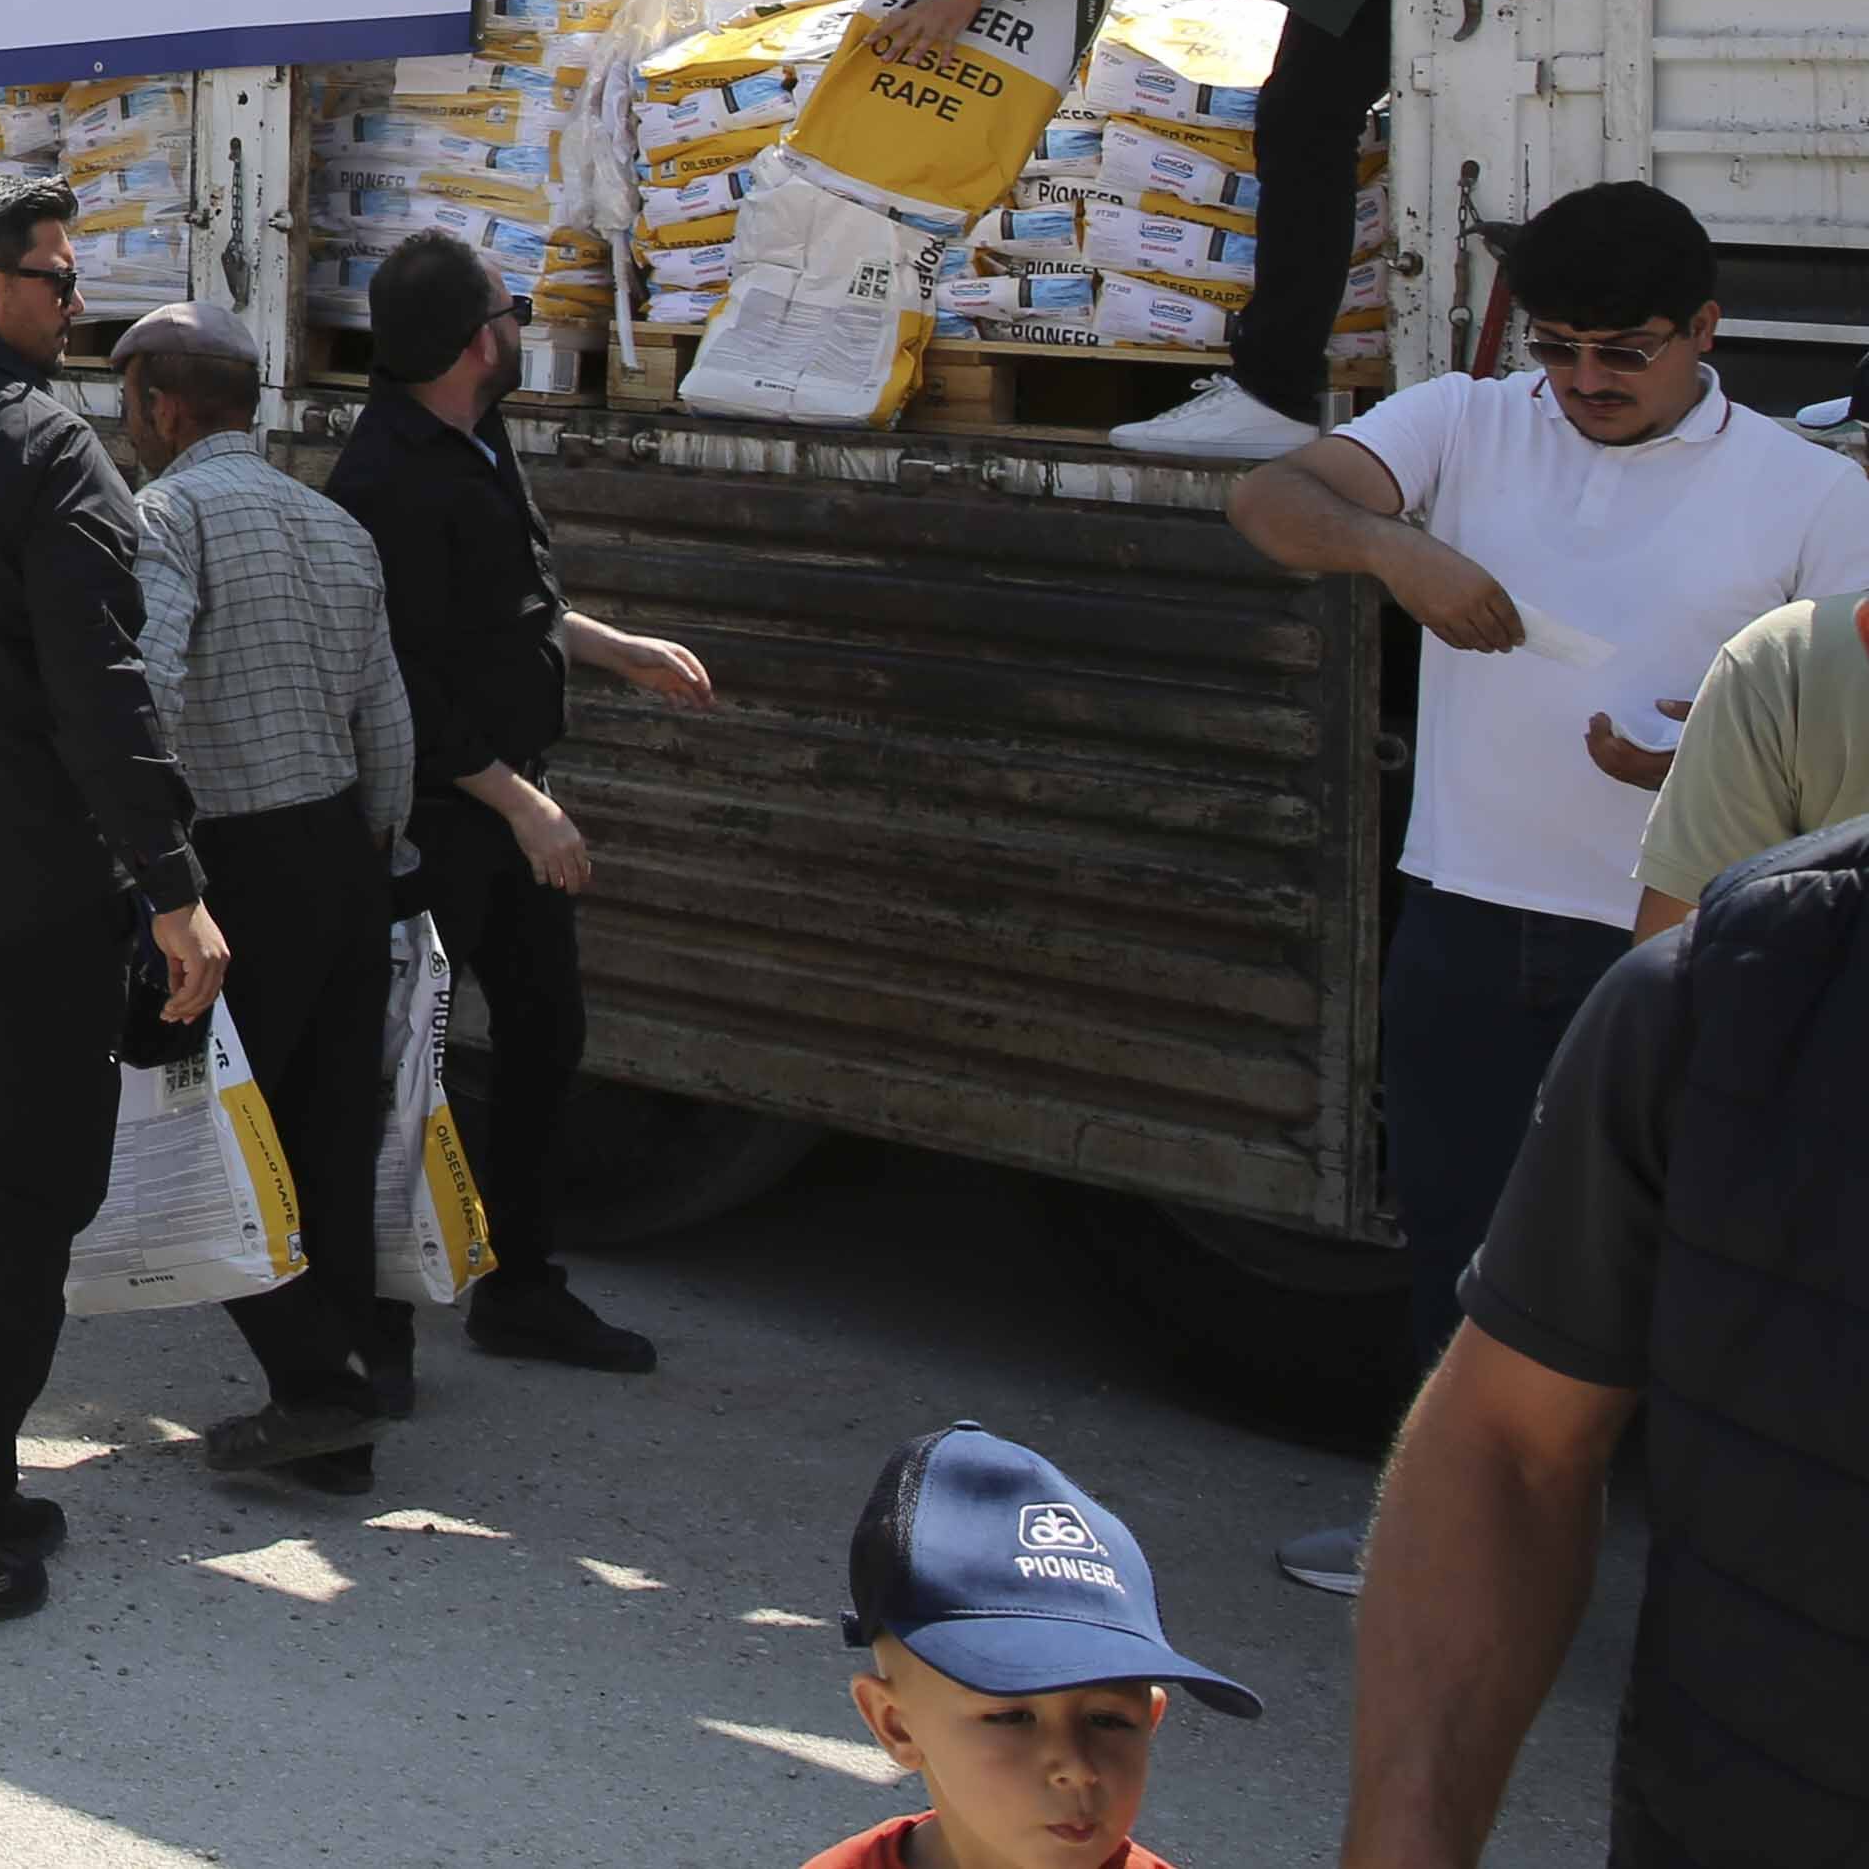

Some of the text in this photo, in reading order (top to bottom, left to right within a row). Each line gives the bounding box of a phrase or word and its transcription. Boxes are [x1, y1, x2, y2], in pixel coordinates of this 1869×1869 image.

[871, 34, 1004, 98] OLSEED
[869, 72, 963, 122] RAPE
[1012, 323, 1100, 347] PIONEER
[435, 1124, 466, 1196] OILSEED
[1015, 1555, 1121, 1591] PIONEER
